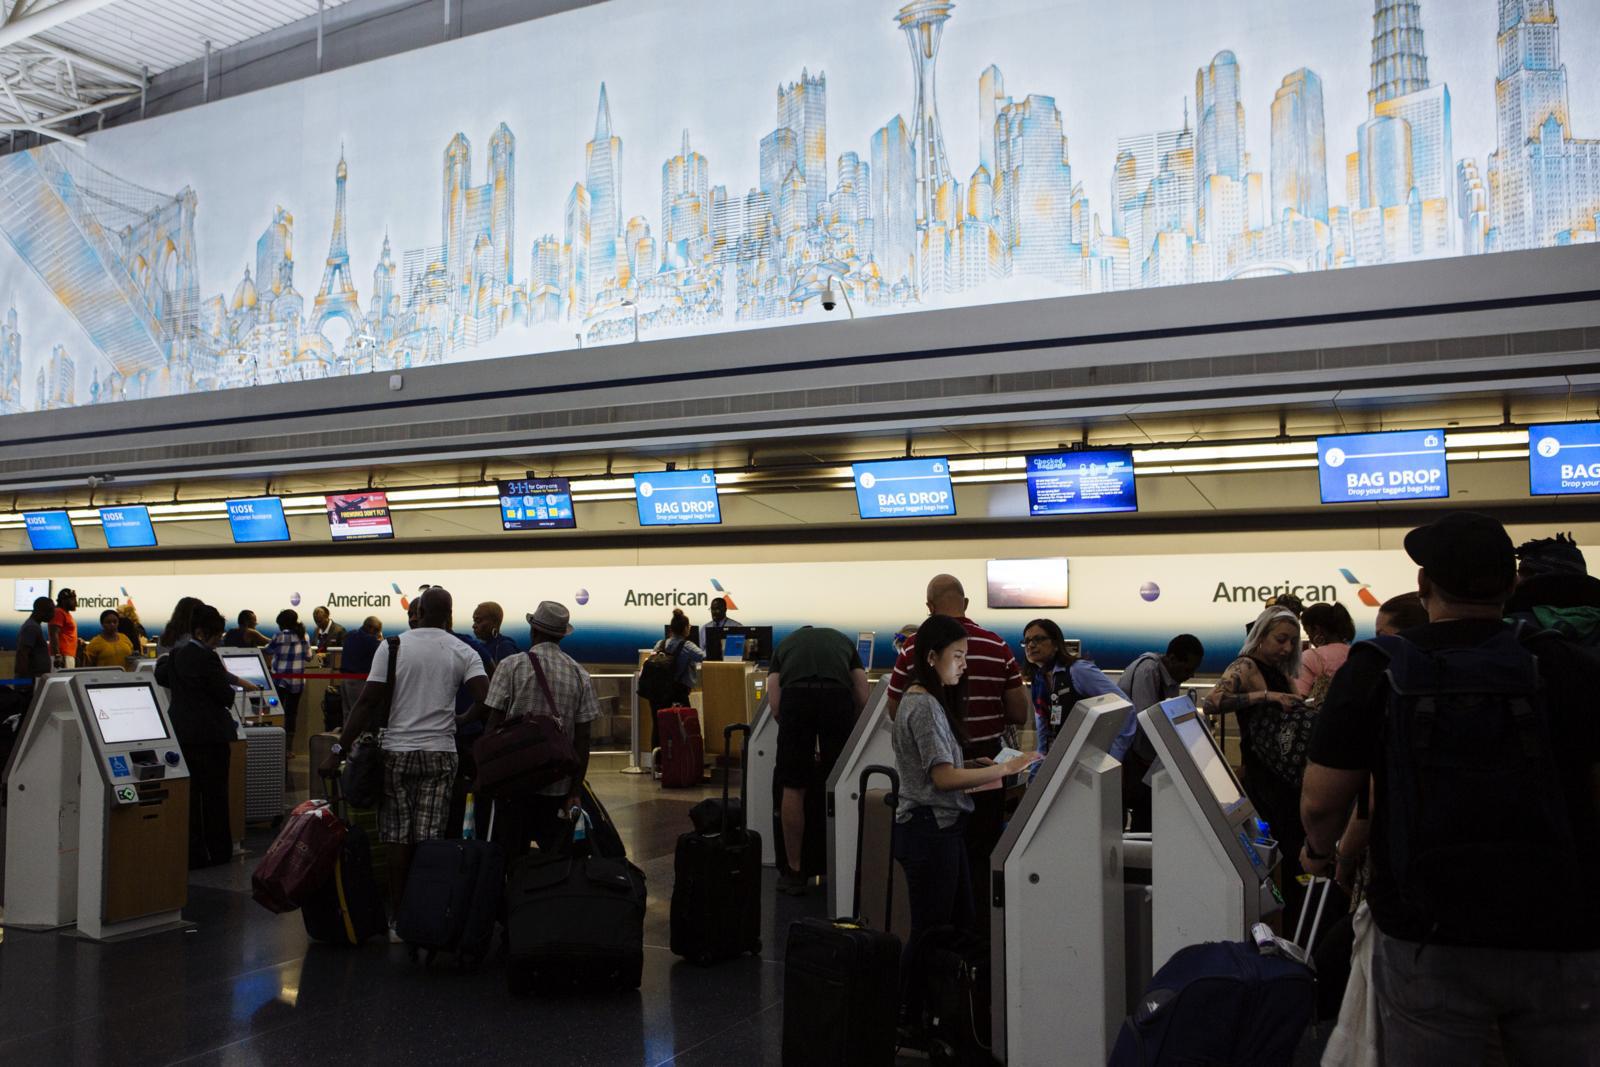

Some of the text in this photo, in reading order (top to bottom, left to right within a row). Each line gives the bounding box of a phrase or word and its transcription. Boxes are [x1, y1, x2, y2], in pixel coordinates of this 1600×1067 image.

[1034, 457, 1063, 465] Checked
[1561, 463, 1600, 479] BAG
[1346, 468, 1441, 488] BAG DROP
[1561, 480, 1599, 488] Drop your
[1348, 484, 1440, 496] Drop your tagged bags here
[878, 491, 948, 506] BAG DROP
[230, 504, 254, 514] KIOSK
[654, 501, 715, 514] BAG DROP
[26, 516, 47, 525] KIOSK
[102, 512, 125, 520] KIOSK
[623, 588, 709, 607] American
[1212, 580, 1337, 602] American
[76, 594, 119, 608] merican
[327, 591, 391, 607] American
